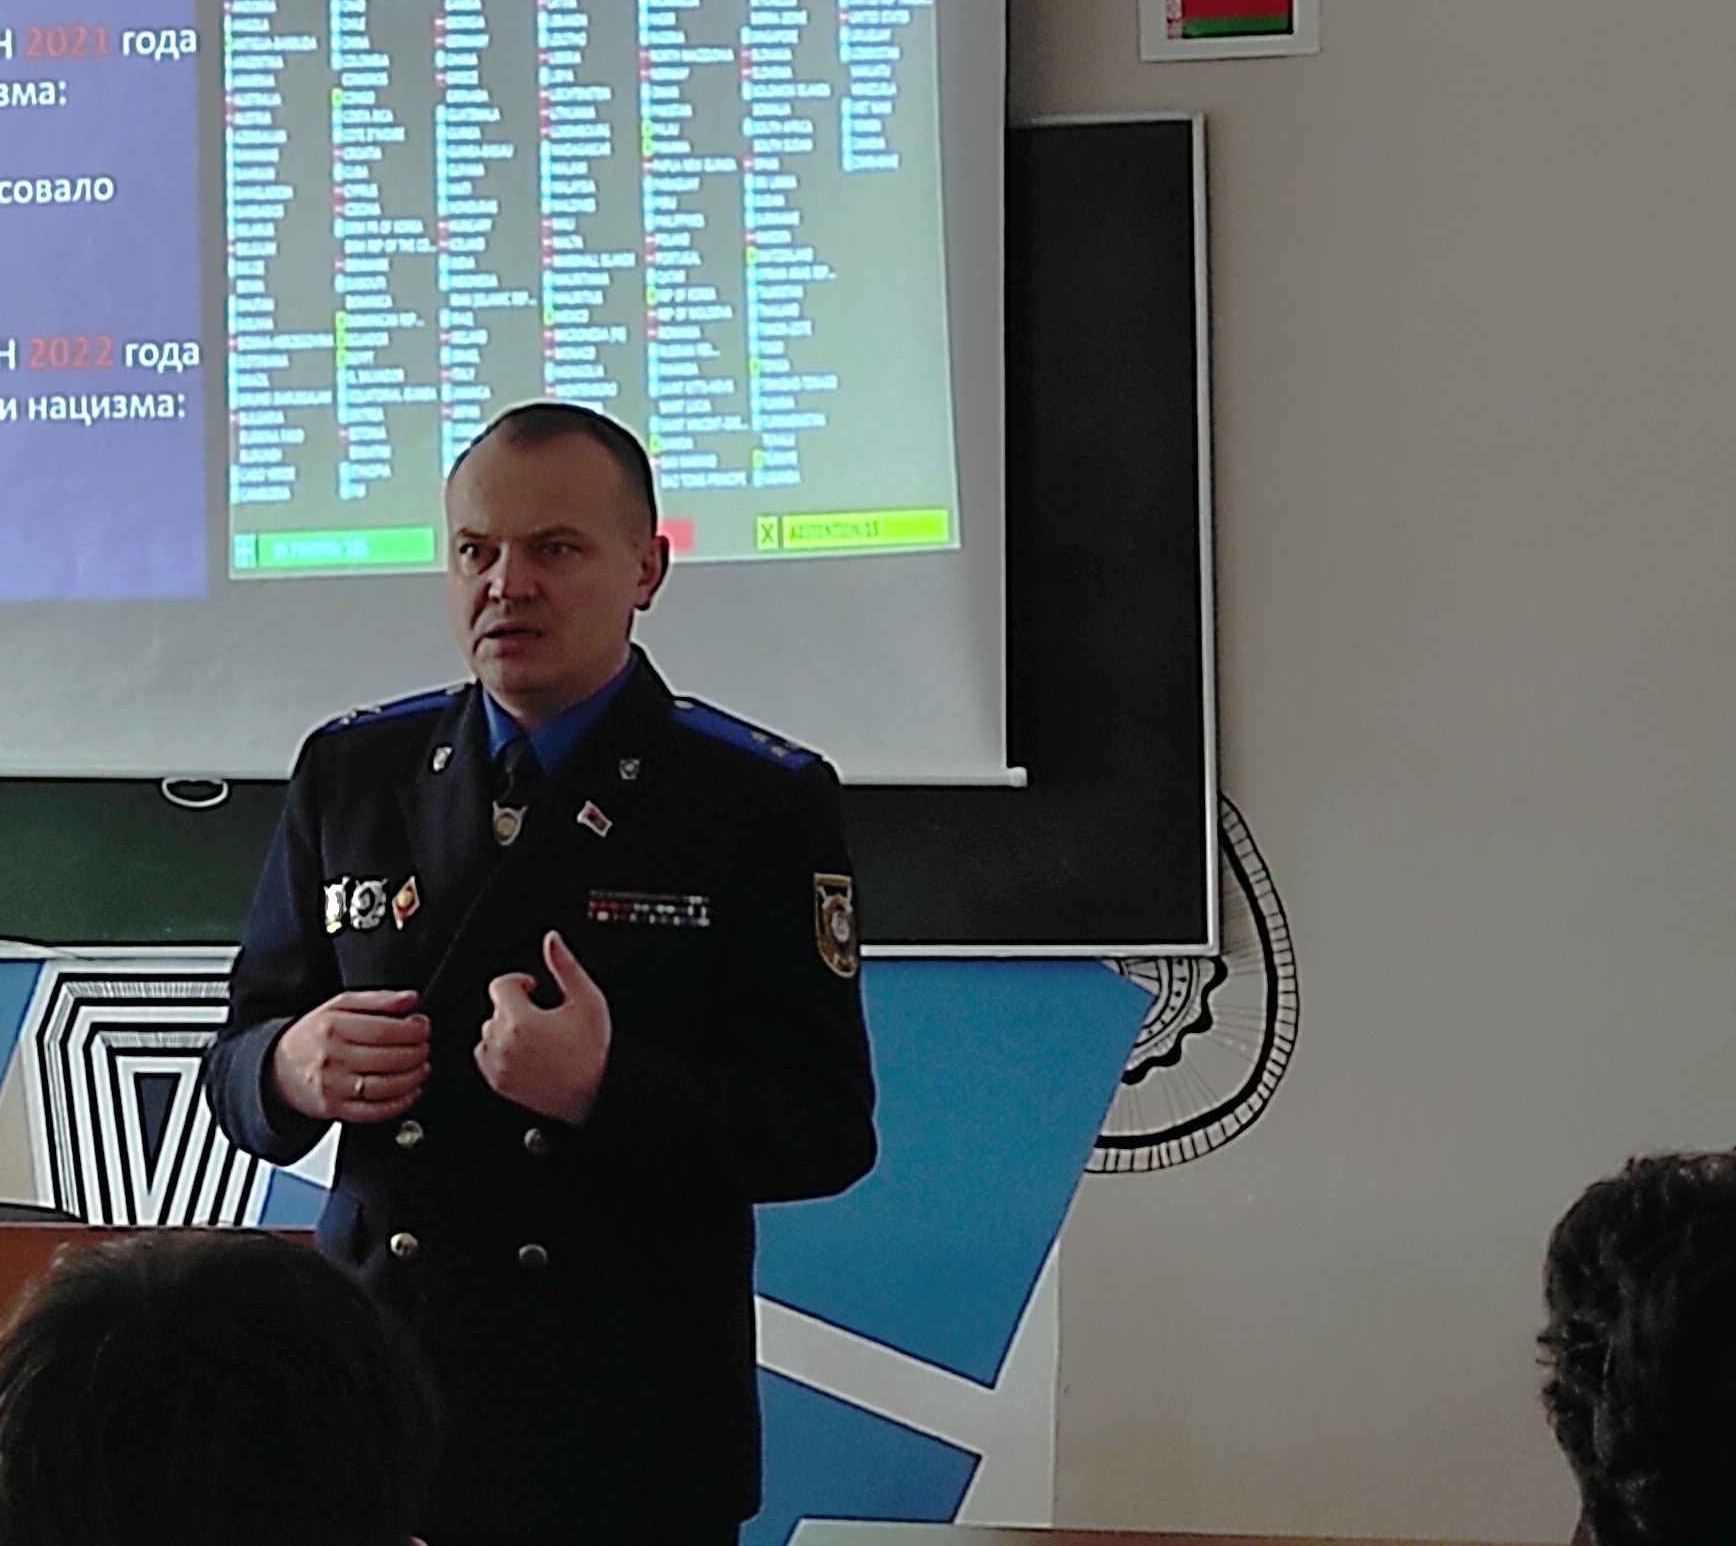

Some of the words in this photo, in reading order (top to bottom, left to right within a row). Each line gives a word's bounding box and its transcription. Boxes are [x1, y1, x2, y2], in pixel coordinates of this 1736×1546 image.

[25, 26, 107, 58] 2021
[123, 29, 197, 61] года
[29, 336, 112, 369] 2022
[126, 342, 200, 373] года
[28, 394, 185, 426] нацизма:
